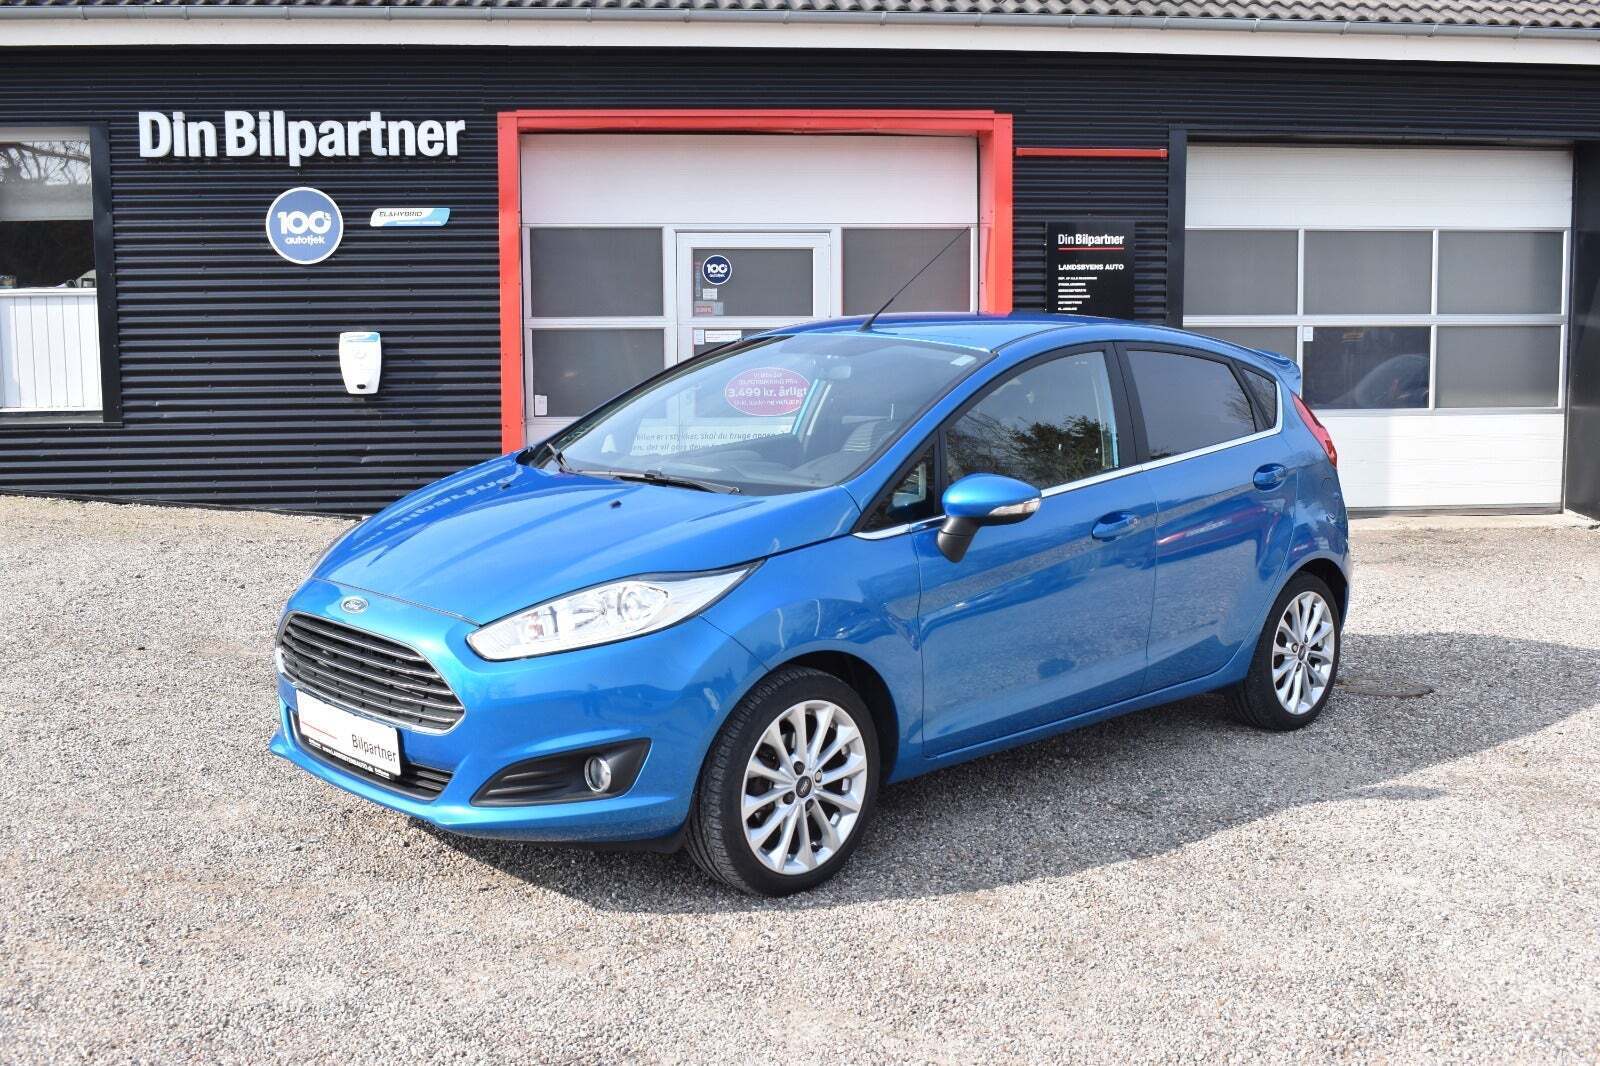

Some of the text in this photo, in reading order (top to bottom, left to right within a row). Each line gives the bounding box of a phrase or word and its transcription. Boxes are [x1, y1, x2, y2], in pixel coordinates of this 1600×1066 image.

[138, 110, 466, 167] Din Bilpartner
[284, 234, 326, 246] autotjek
[1057, 233, 1124, 246] Din Bilpartner
[351, 734, 397, 763] Bilpartner
